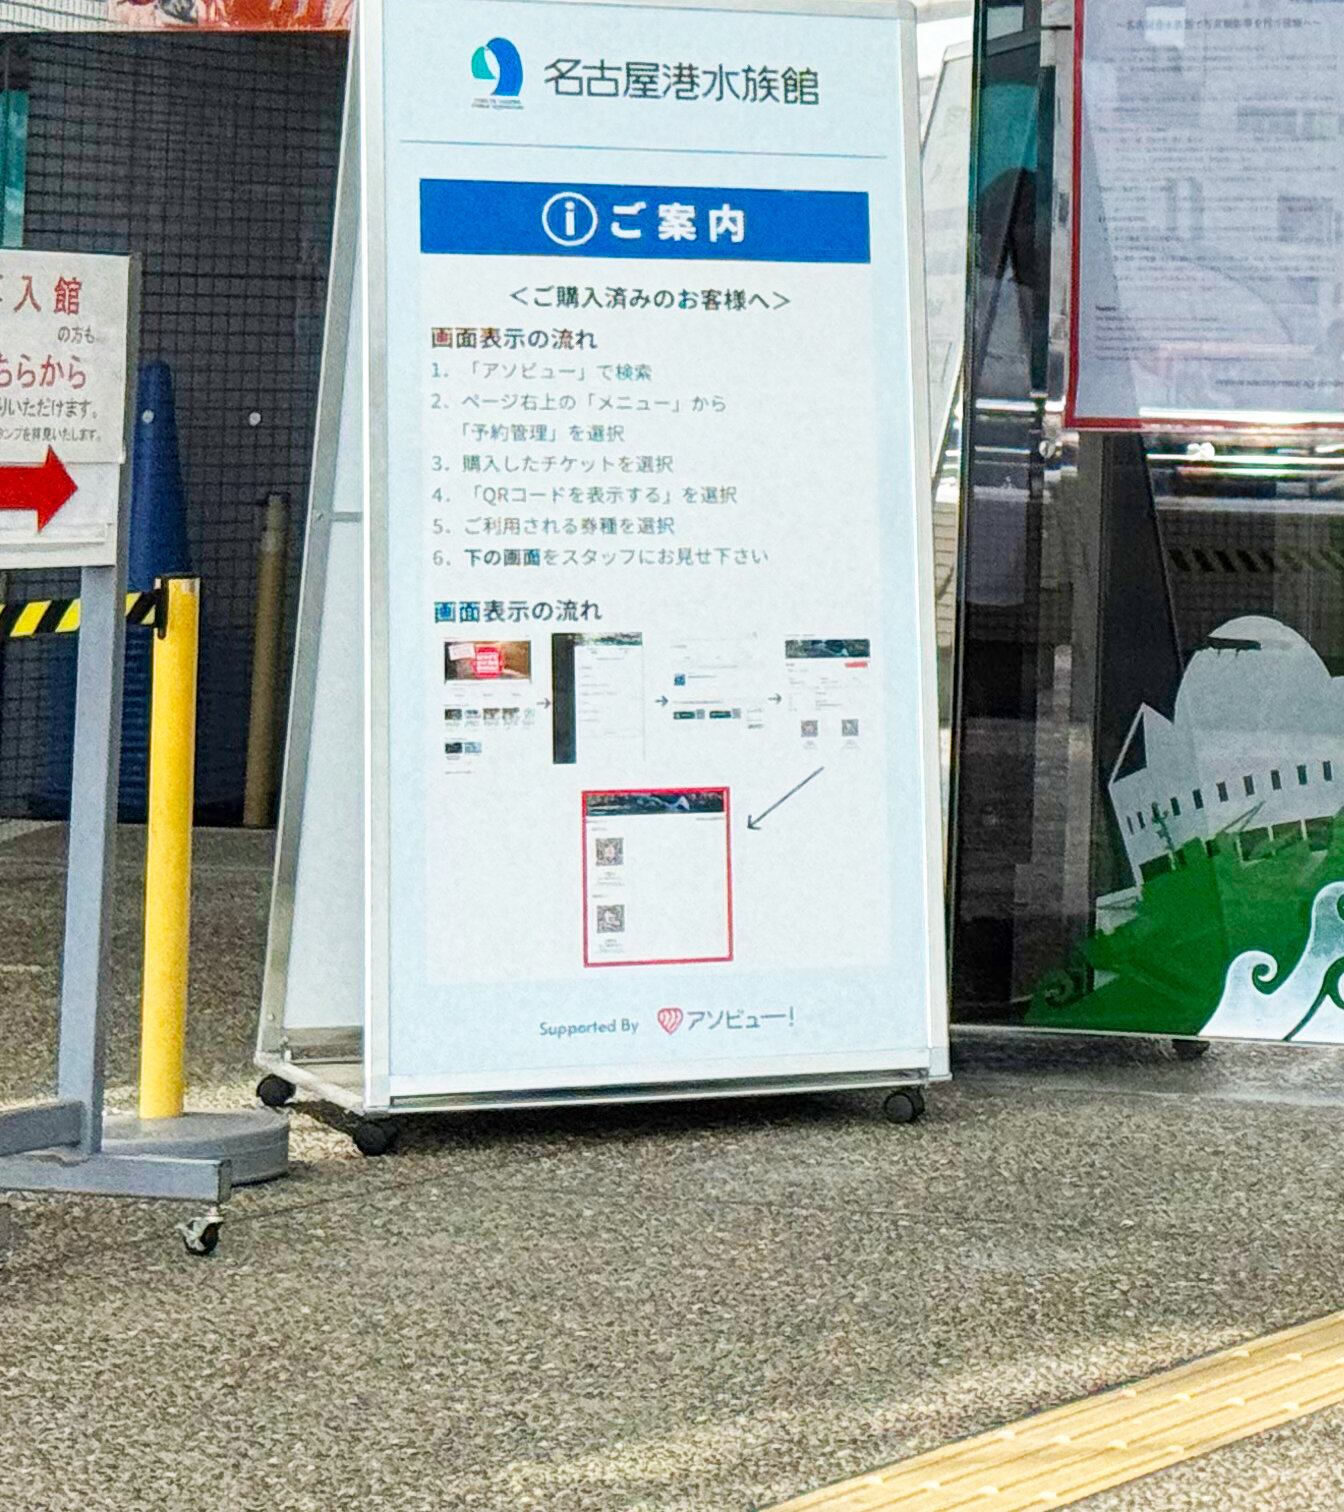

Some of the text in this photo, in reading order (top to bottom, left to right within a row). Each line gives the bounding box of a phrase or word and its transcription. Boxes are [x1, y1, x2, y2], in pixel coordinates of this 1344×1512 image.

[543, 58, 820, 106] 名古屋港水族館
[610, 202, 745, 243] ご案内
[0, 274, 82, 315] 入館
[431, 328, 599, 350] 画面表示の流れ
[463, 455, 674, 473] 購入したチケットを選択
[434, 600, 601, 623] 画面表示の流れ
[539, 1019, 639, 1039] Supported By
